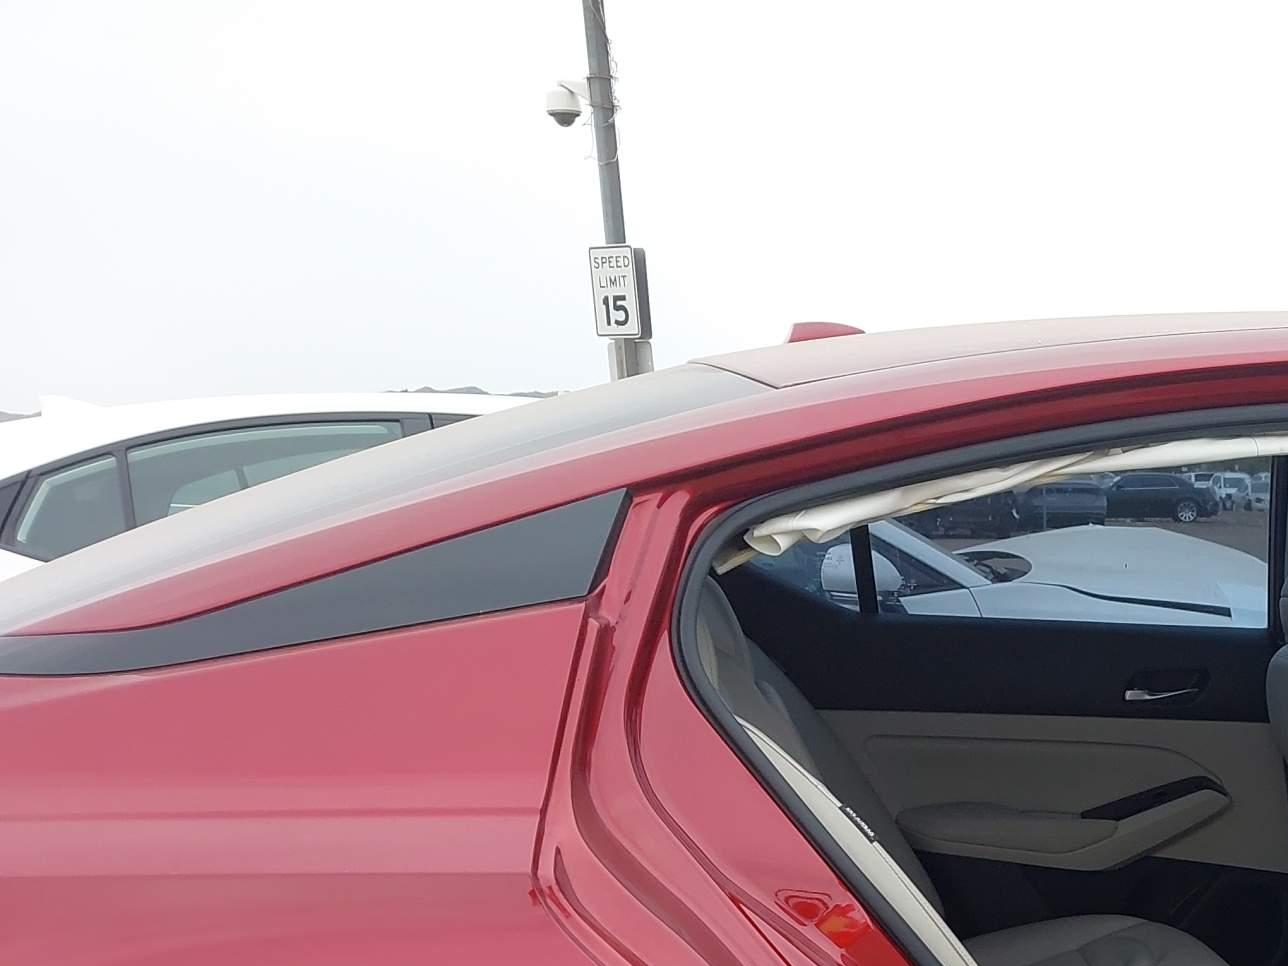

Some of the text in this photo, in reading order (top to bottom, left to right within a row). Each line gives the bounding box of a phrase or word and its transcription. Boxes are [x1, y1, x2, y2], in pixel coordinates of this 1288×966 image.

[593, 255, 630, 269] SPEED
[599, 275, 628, 288] LIMIT
[602, 294, 630, 327] 15
